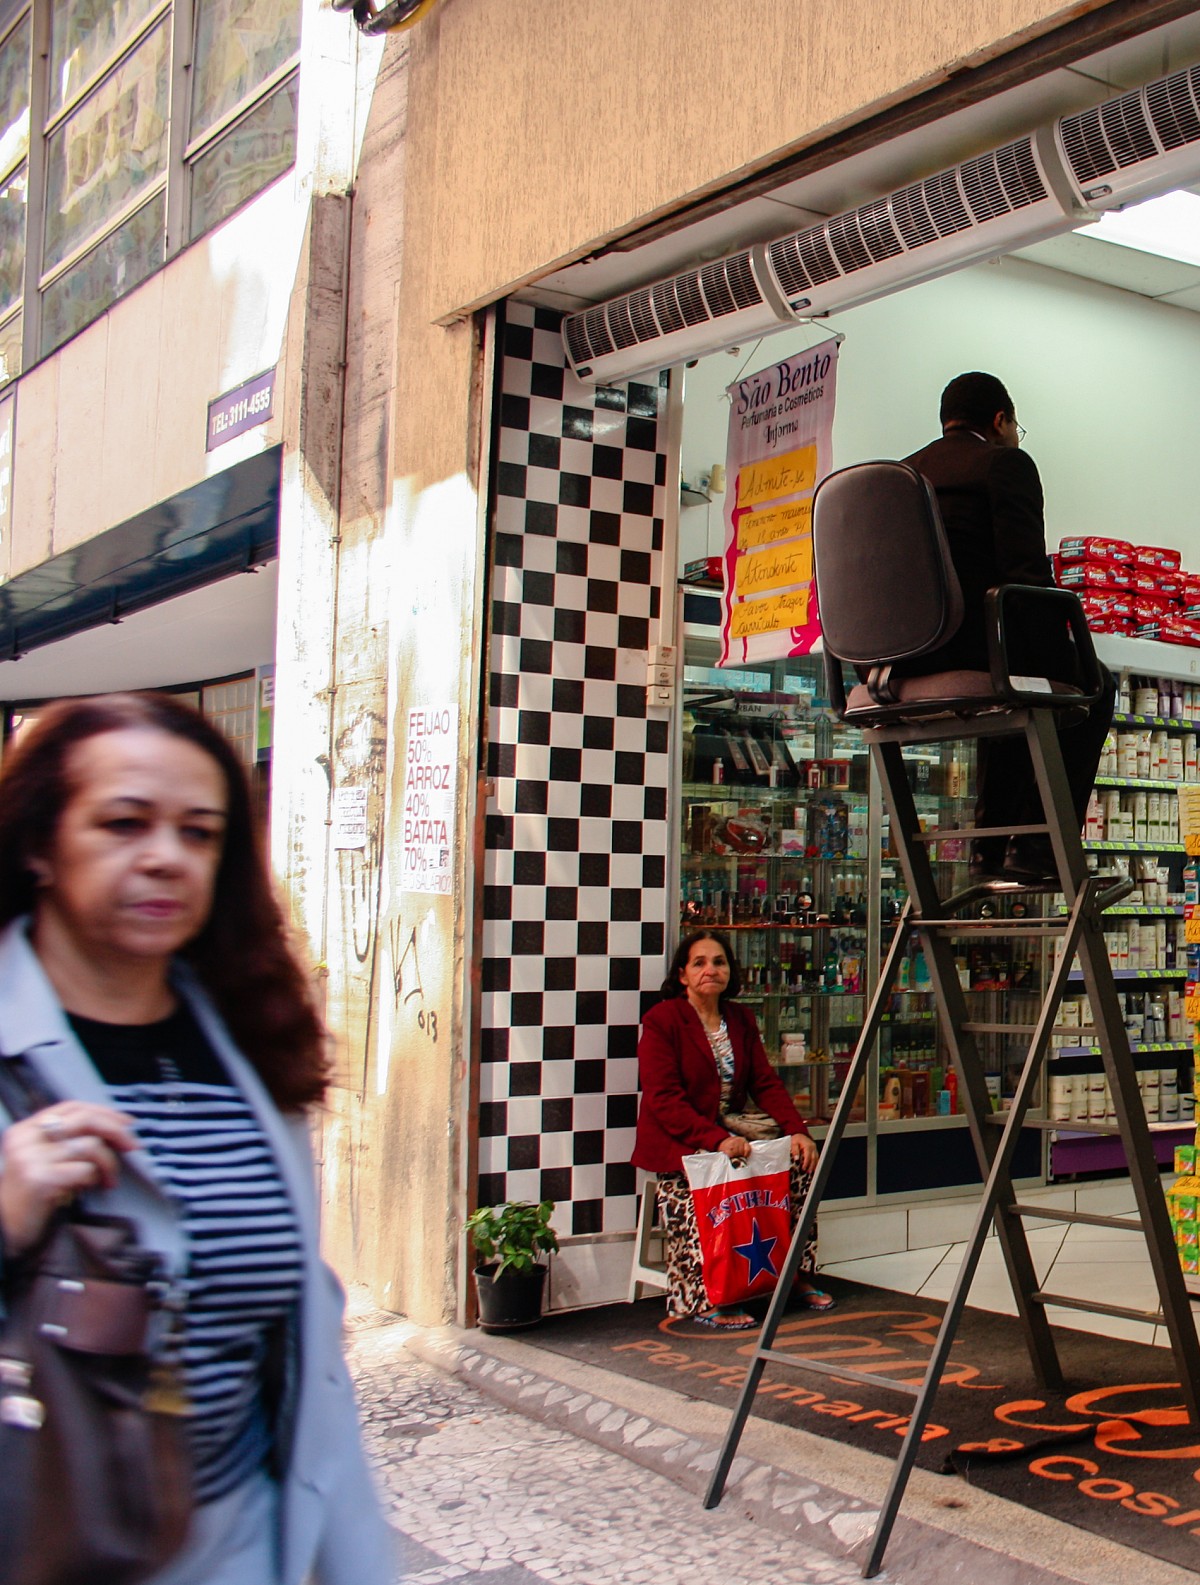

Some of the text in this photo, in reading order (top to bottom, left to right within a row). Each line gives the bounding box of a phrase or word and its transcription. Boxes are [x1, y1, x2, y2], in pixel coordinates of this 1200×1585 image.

[737, 353, 831, 415] São Bento
[212, 386, 271, 436] TEL: 3111-4555
[741, 385, 824, 430] Perfumaria e Cosméticos
[737, 704, 762, 713] RBAN
[409, 709, 450, 737] FEIJAO
[407, 739, 432, 764] 50%
[406, 765, 450, 790] ARROZ
[405, 793, 430, 818] 40%
[404, 819, 449, 845] BATATA
[404, 847, 427, 872] 70%
[609, 1338, 950, 1443] Perfumaria
